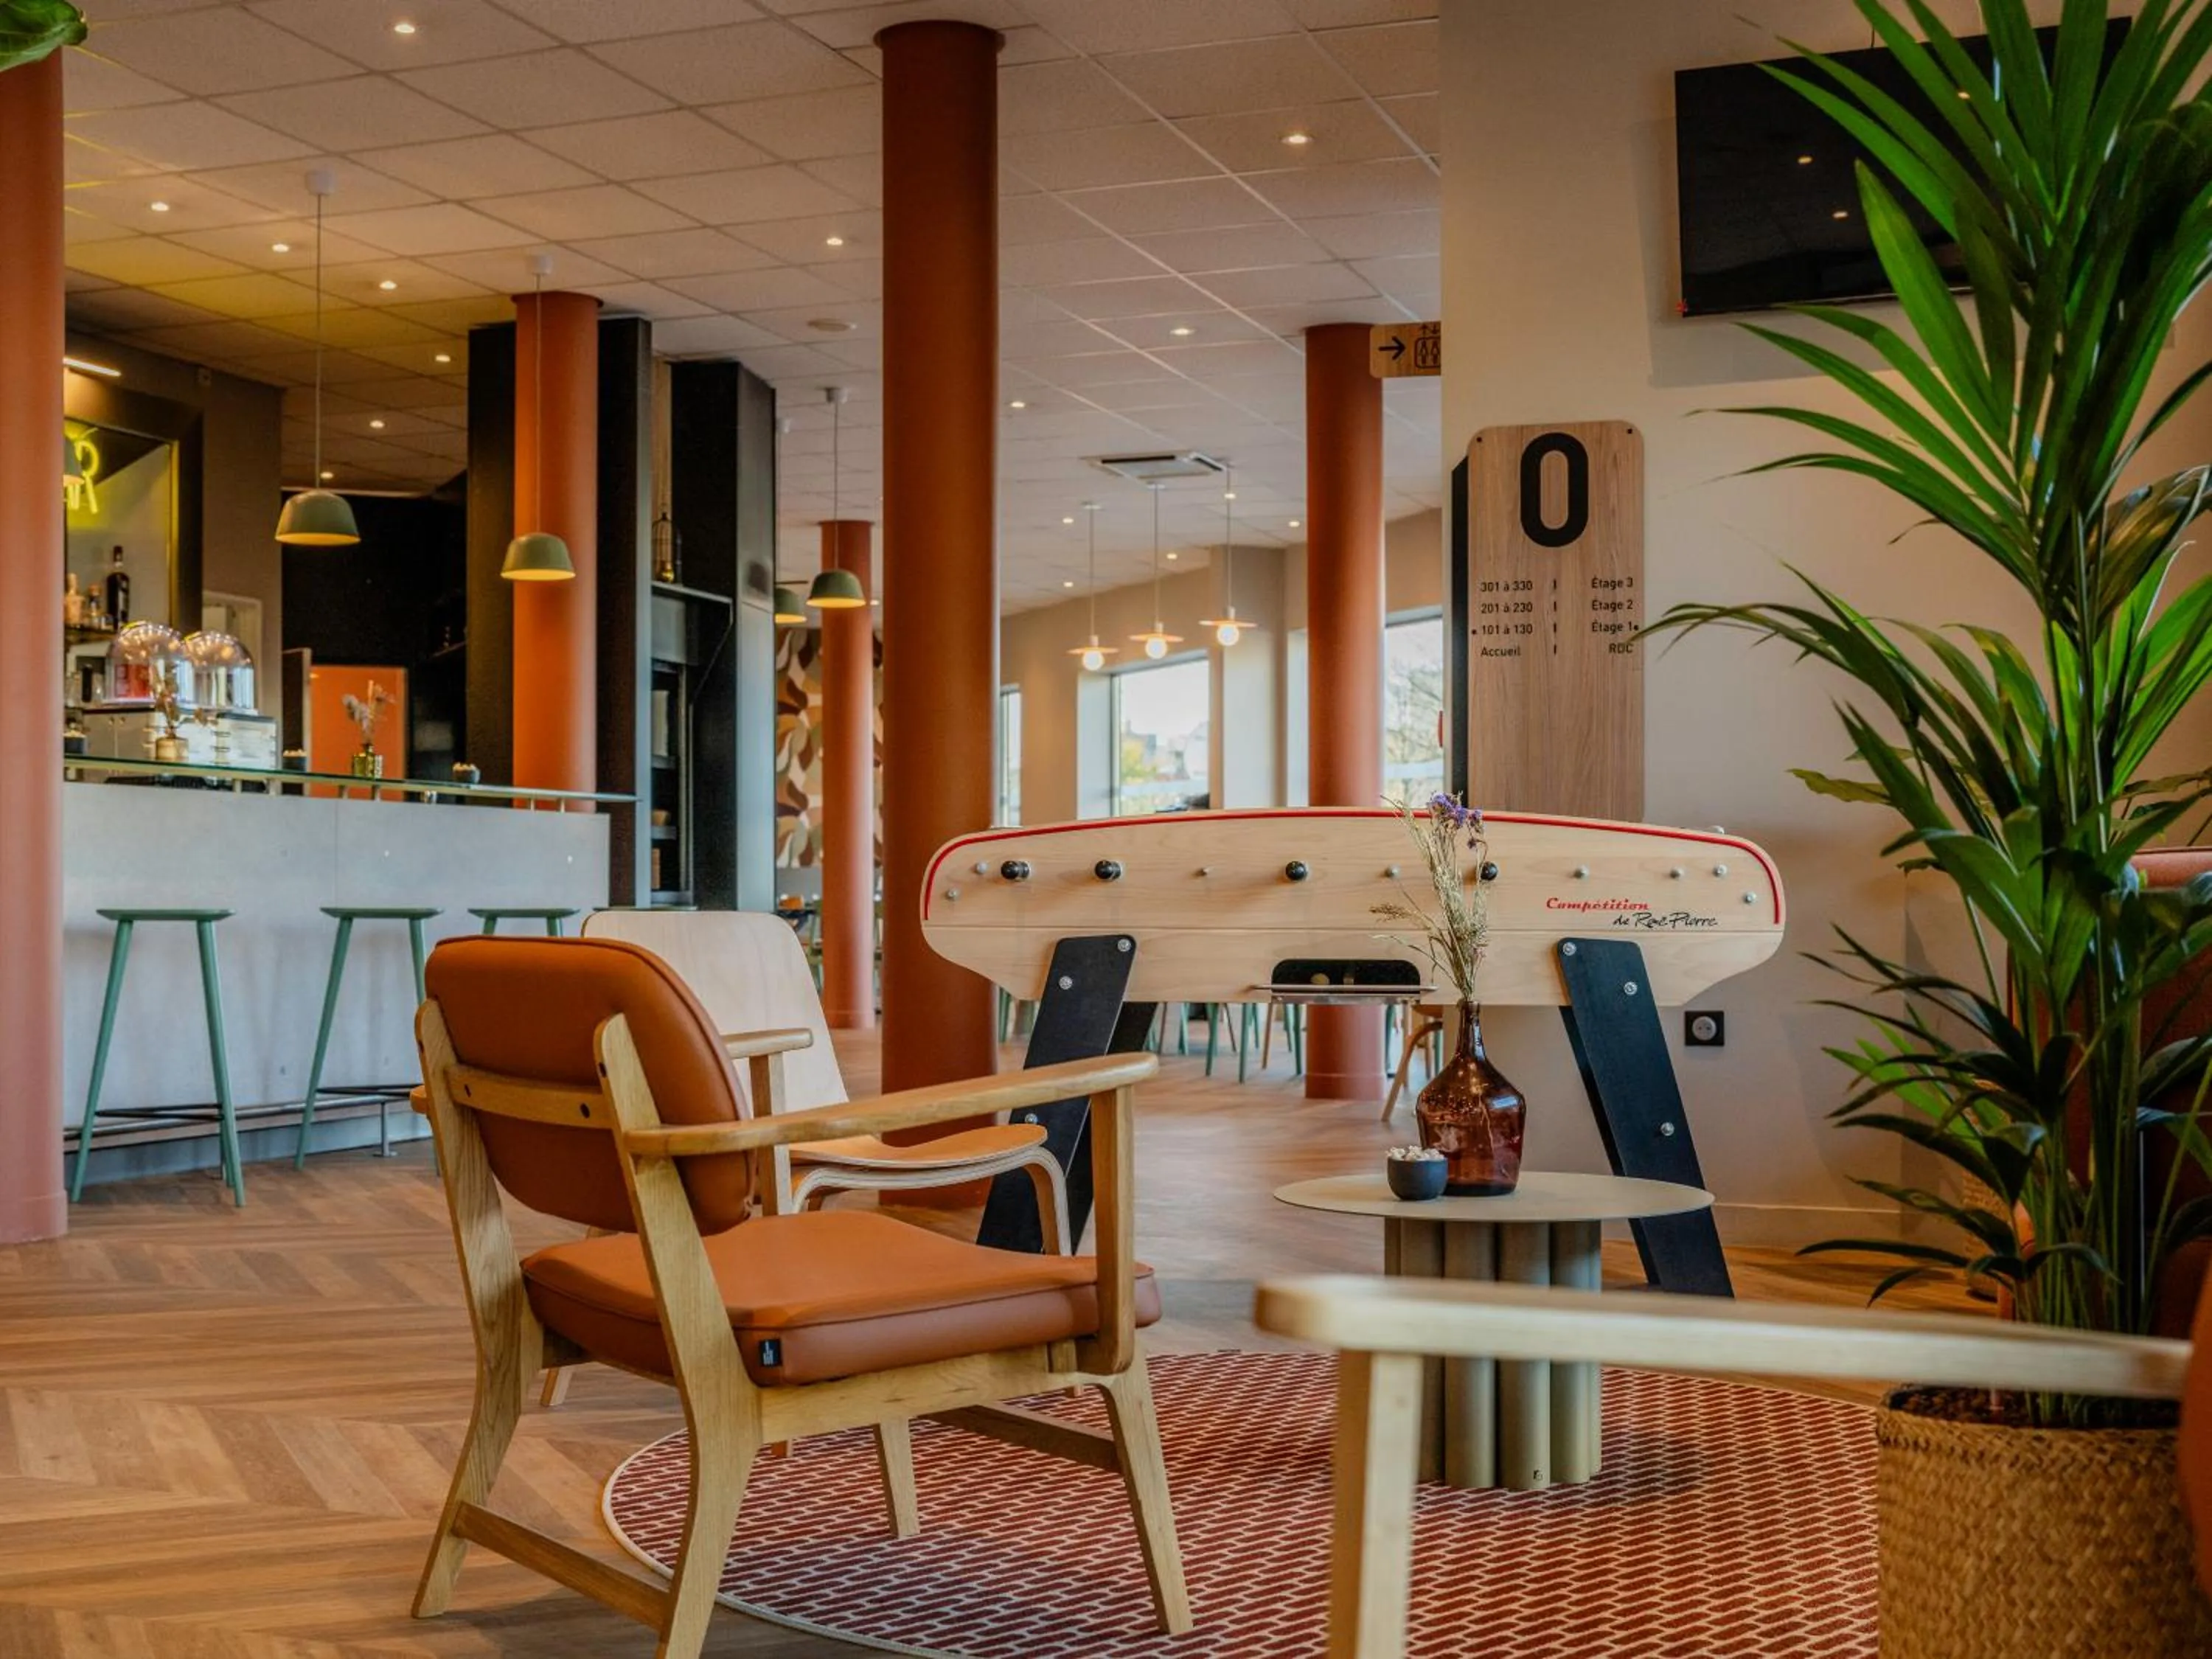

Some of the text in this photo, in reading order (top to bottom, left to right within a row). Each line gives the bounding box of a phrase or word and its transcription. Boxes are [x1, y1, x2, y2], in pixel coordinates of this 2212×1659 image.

[1520, 432, 1589, 547] 0
[1481, 580, 1533, 592] 301 à 330
[1592, 575, 1633, 590] Étage 3
[1481, 603, 1499, 614] 201
[1513, 602, 1533, 613] 230
[1592, 597, 1633, 613] Étage 2
[1482, 624, 1500, 635] 101
[1514, 623, 1533, 635] 130
[1592, 619, 1632, 635] Étage 1
[1481, 645, 1521, 657] Accueil
[1609, 642, 1633, 654] RDC
